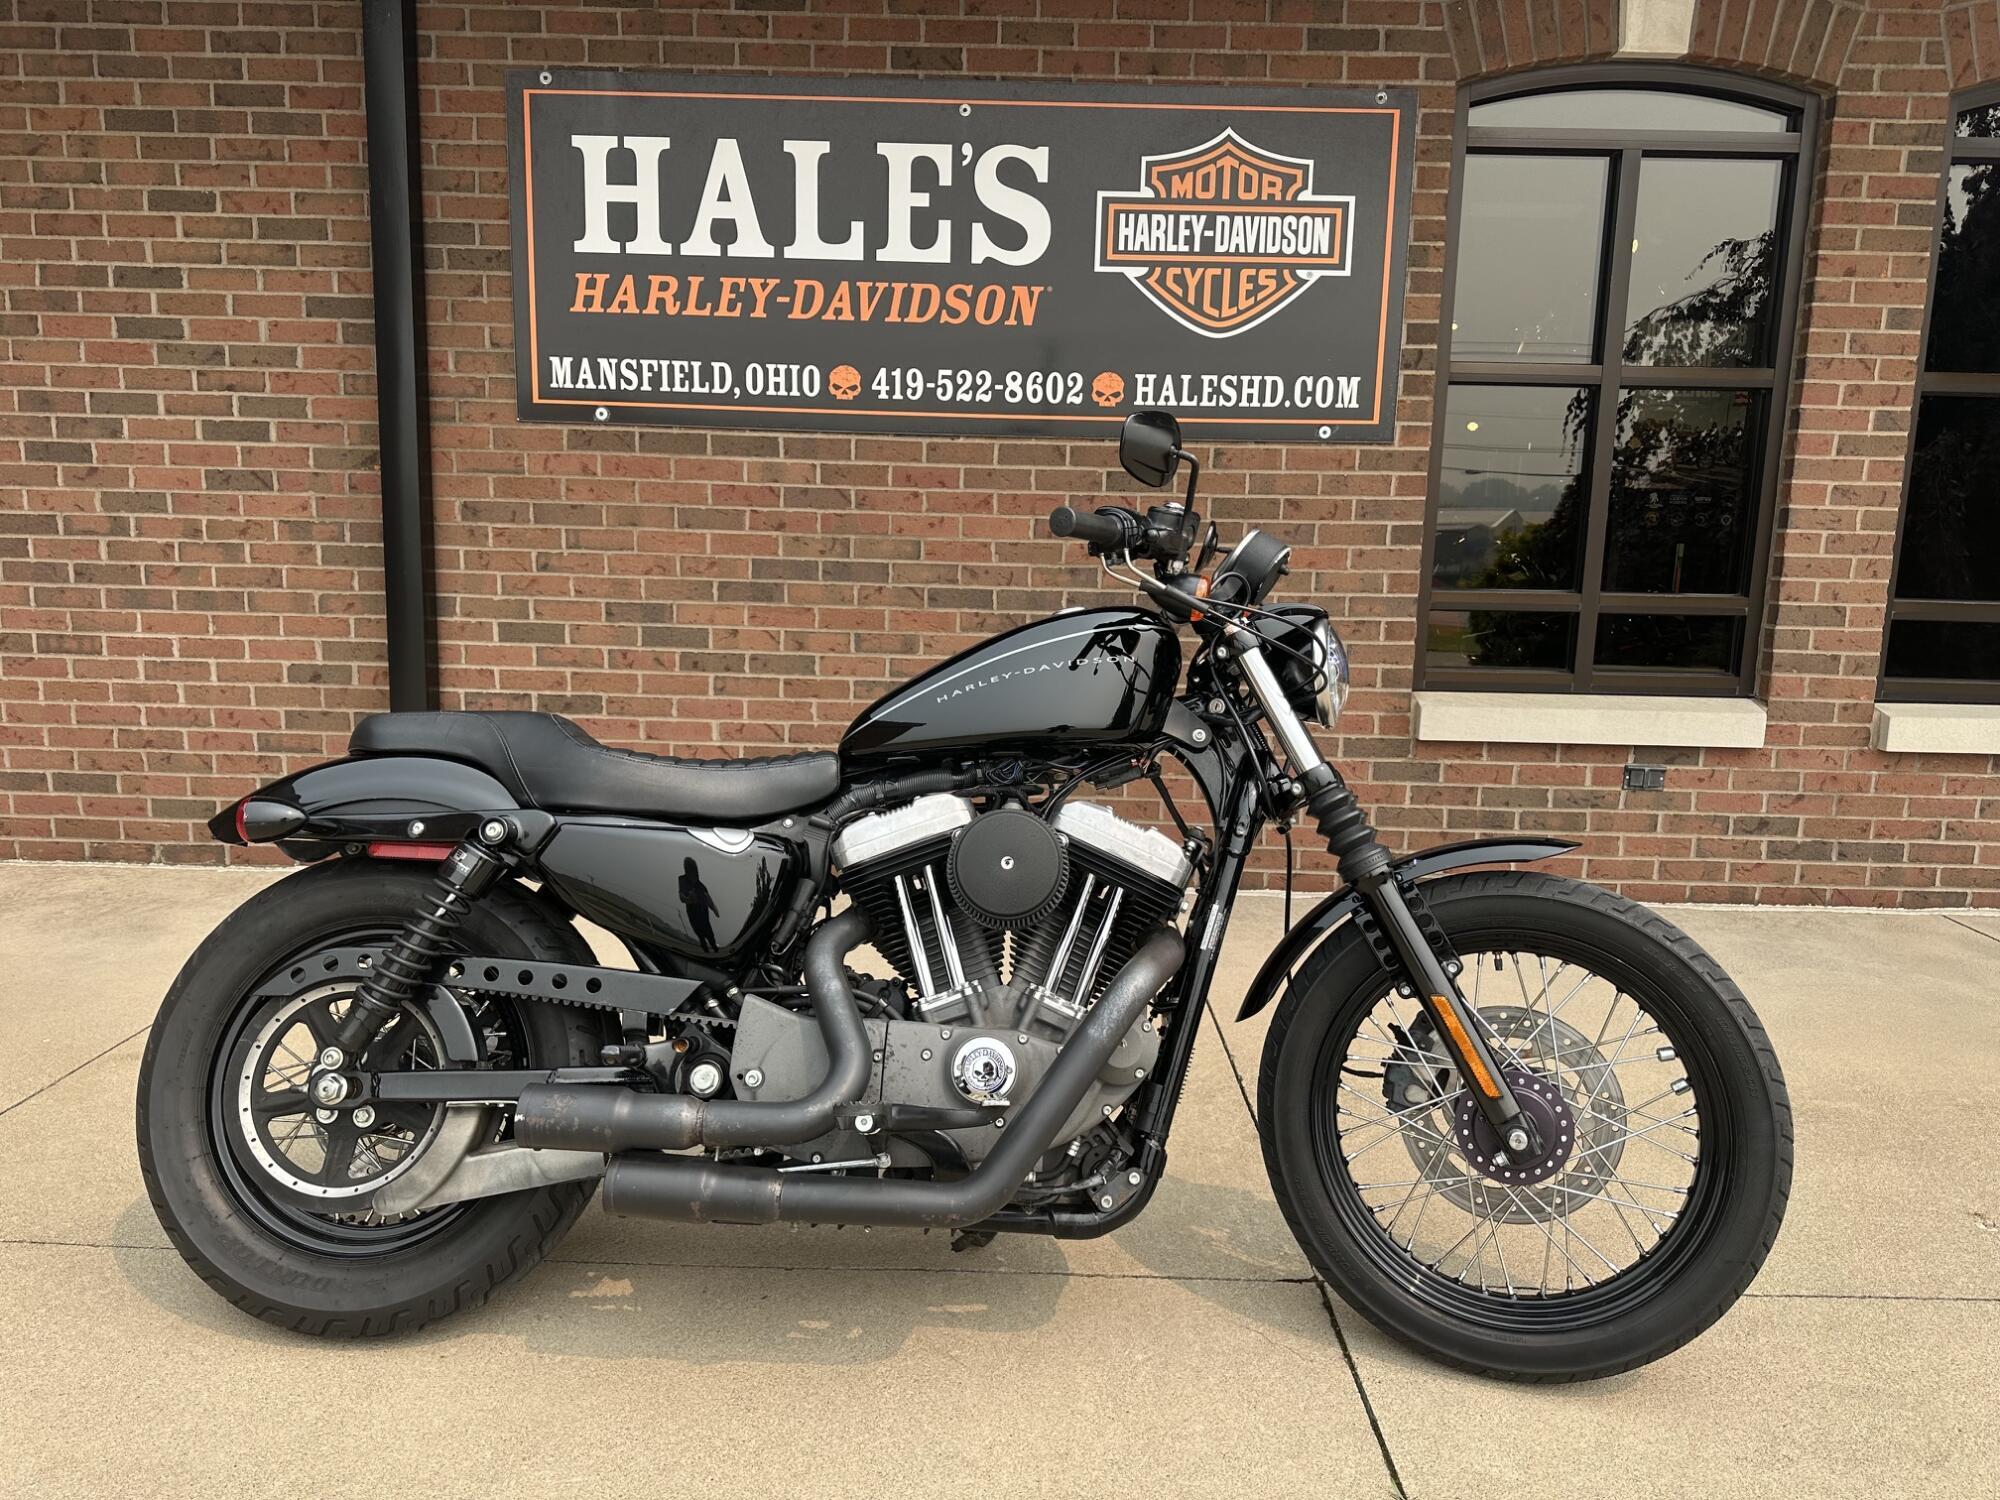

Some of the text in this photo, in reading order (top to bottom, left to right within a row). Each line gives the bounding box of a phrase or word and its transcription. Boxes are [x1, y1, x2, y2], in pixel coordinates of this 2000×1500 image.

[571, 134, 1052, 266] HALE'S
[1171, 155, 1283, 201] MOTOR
[1118, 213, 1331, 255] HARLEY-DAVIDSON
[569, 273, 1044, 326] HARLEY-DAVIDSON
[1166, 267, 1277, 318] CYCLES
[871, 367, 1084, 405] 419-522-8602
[1134, 373, 1361, 409] HALESHD.COM
[936, 656, 1135, 703] HARLEY-DAVIDSON
